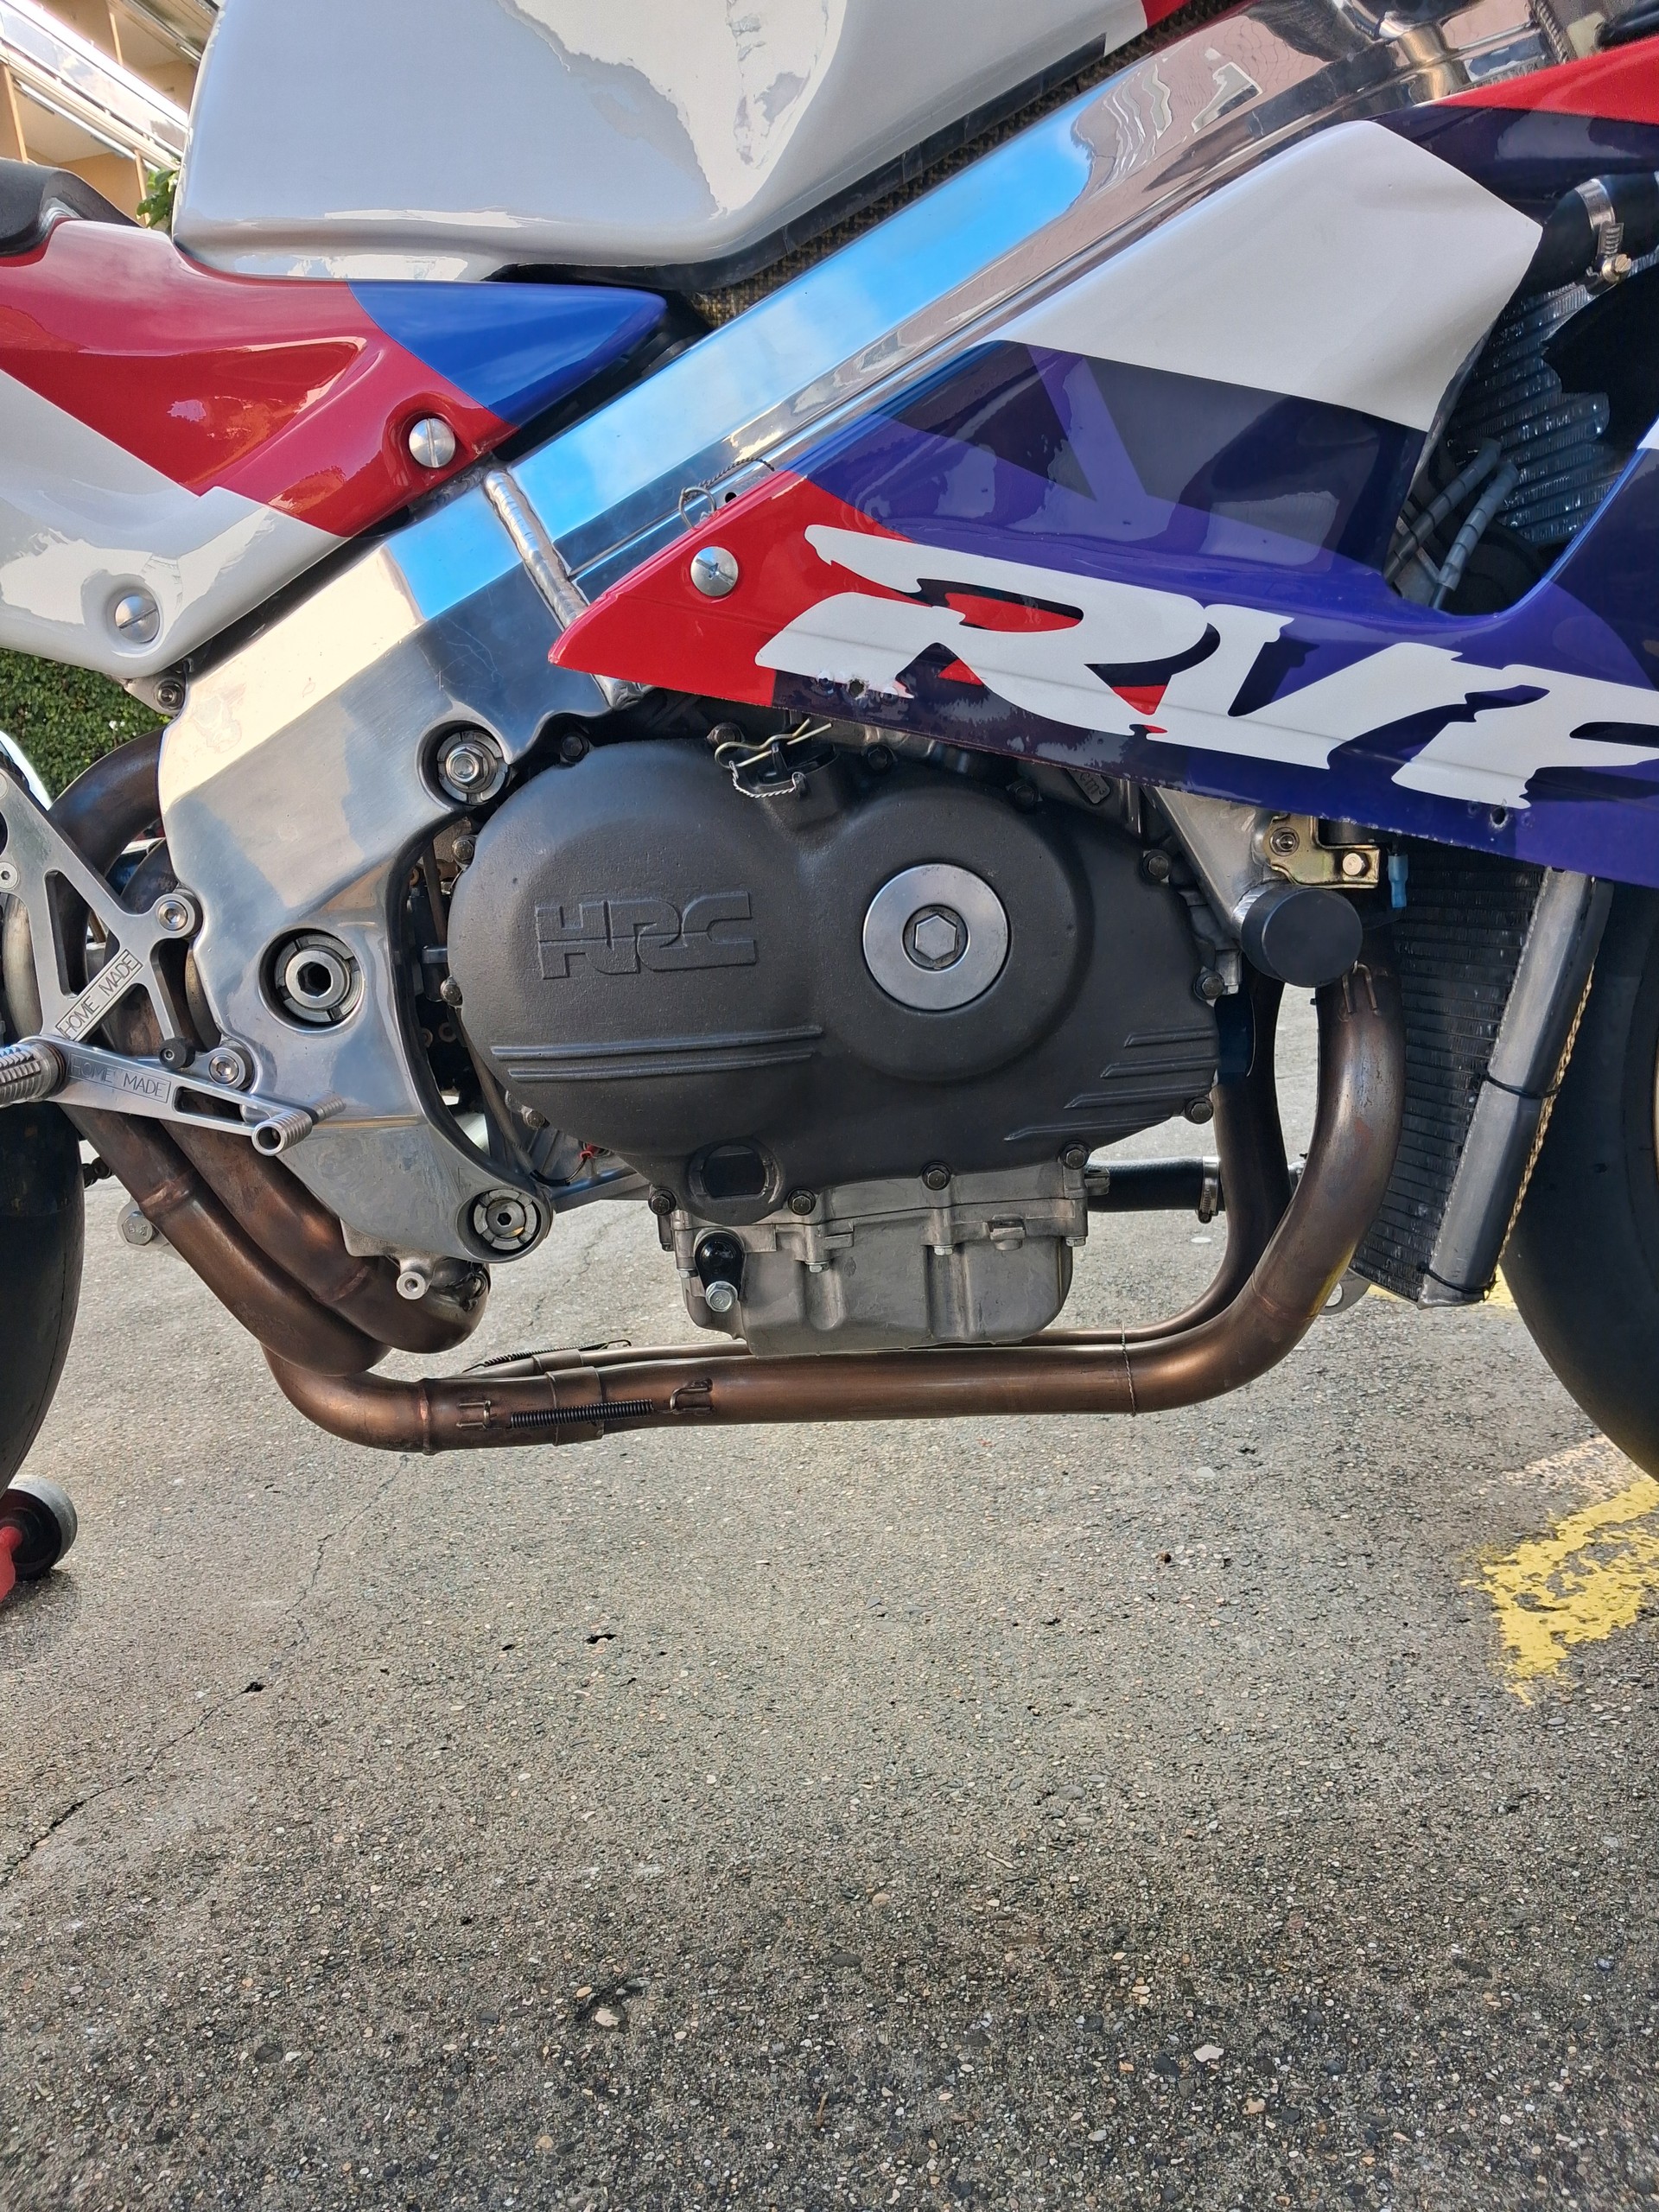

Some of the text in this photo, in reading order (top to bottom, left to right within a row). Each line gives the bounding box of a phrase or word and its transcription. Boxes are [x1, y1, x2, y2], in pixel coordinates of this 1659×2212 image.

[535, 891, 758, 980] HRC
[59, 952, 140, 1039] HOME MADE
[70, 1057, 167, 1098] HOME MADE
